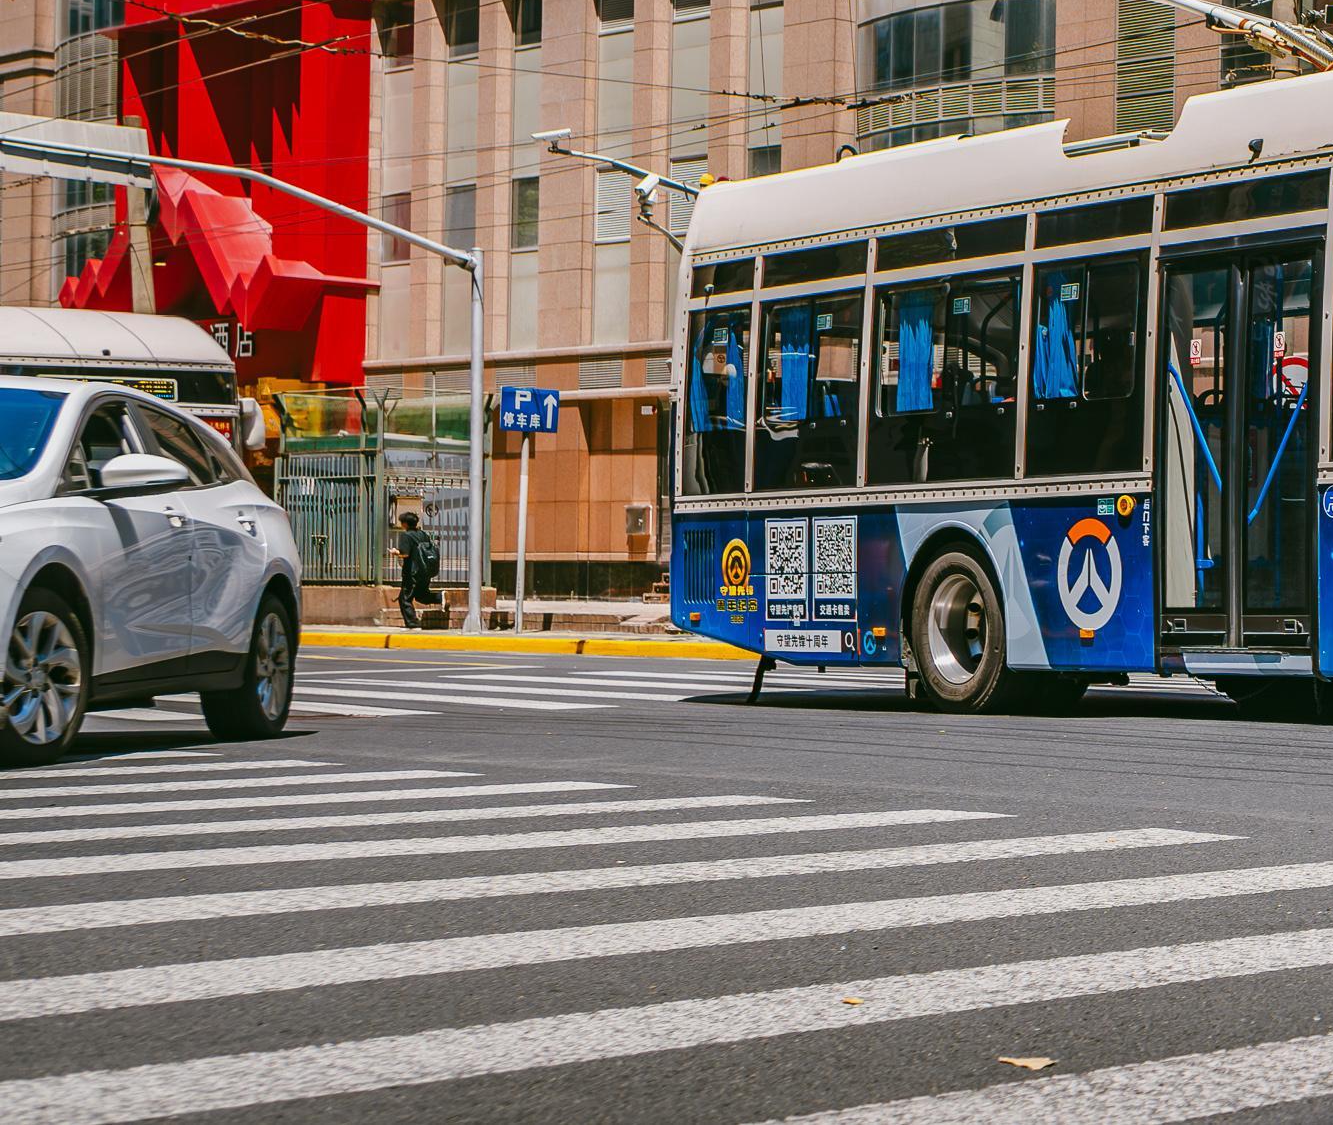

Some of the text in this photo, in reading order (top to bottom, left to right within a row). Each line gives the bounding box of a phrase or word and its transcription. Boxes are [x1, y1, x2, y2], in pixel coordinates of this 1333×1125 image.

[515, 390, 532, 410] P
[503, 411, 541, 429] 停车库
[776, 635, 829, 648] 守望先锋十周年
